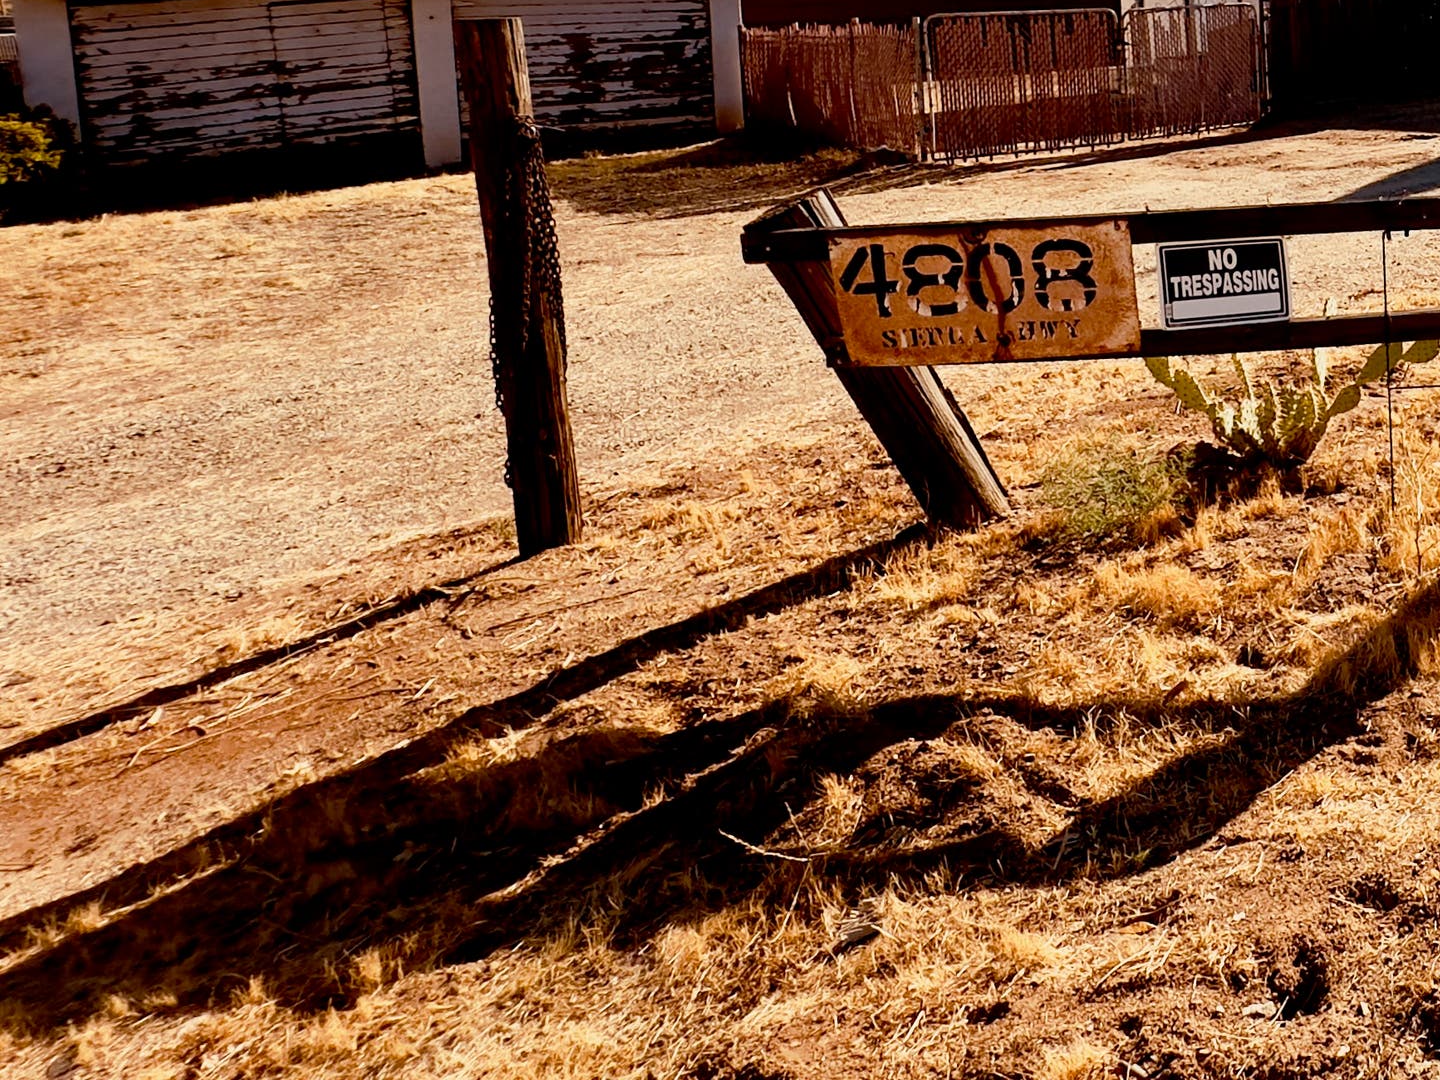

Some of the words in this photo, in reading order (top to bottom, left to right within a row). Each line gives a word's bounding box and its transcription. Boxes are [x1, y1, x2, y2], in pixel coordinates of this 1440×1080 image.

[1207, 247, 1238, 271] NO
[839, 238, 1098, 318] 4808
[1170, 268, 1280, 298] TRESPASSING
[1017, 318, 1081, 341] HWY
